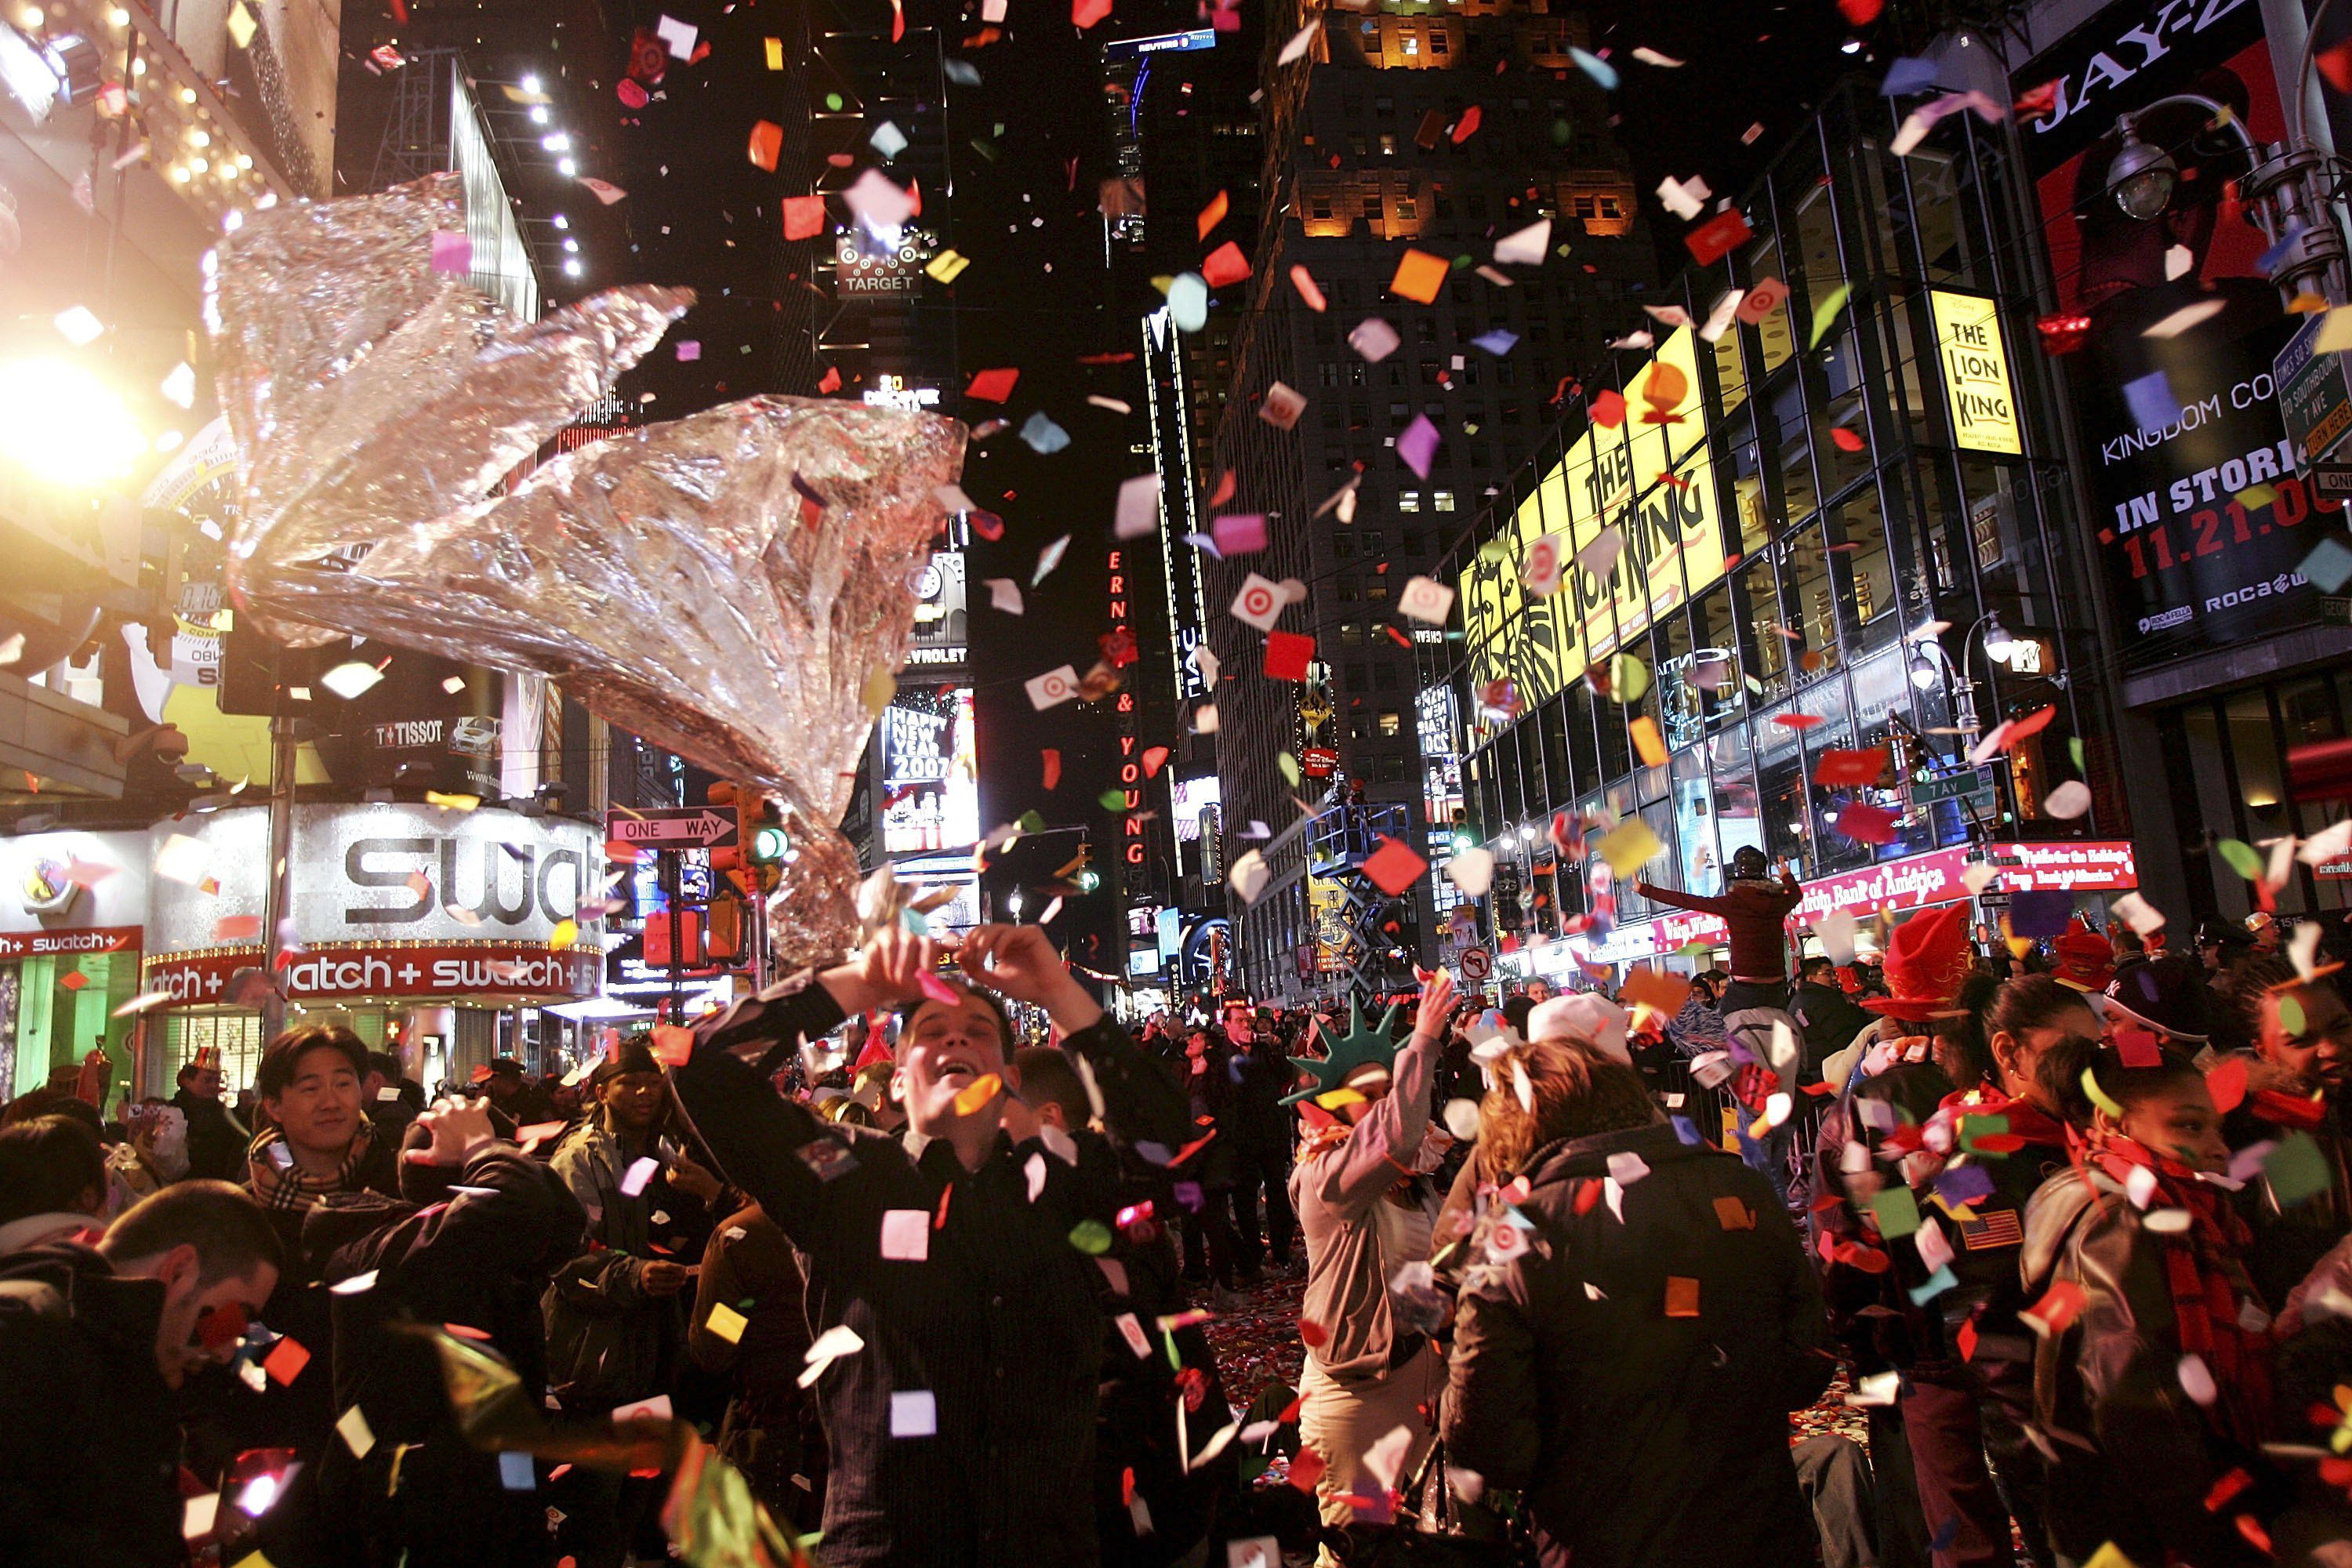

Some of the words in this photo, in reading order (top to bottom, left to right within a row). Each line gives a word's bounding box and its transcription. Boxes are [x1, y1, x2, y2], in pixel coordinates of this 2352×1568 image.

[2034, 0, 2245, 133] JAY-Z
[845, 276, 914, 291] TARGET
[1951, 322, 1987, 346] THE
[1949, 350, 1999, 385] LION
[1956, 390, 2009, 427] KING
[1584, 440, 1628, 515] THE
[2115, 491, 2160, 534] IN
[1618, 468, 1704, 603] KING
[1109, 551, 1127, 668] ERN
[1116, 692, 1134, 712] &
[892, 706, 947, 731] HAPPY
[395, 720, 443, 745] TISSOT
[892, 722, 935, 743] NEW
[892, 738, 940, 758] YEAR
[892, 757, 950, 780] 2007
[1120, 736, 1145, 863] YOUNG
[1929, 785, 1936, 797] 7
[626, 821, 661, 838] ONE
[685, 819, 722, 836] WAY
[33, 932, 103, 951] swatch
